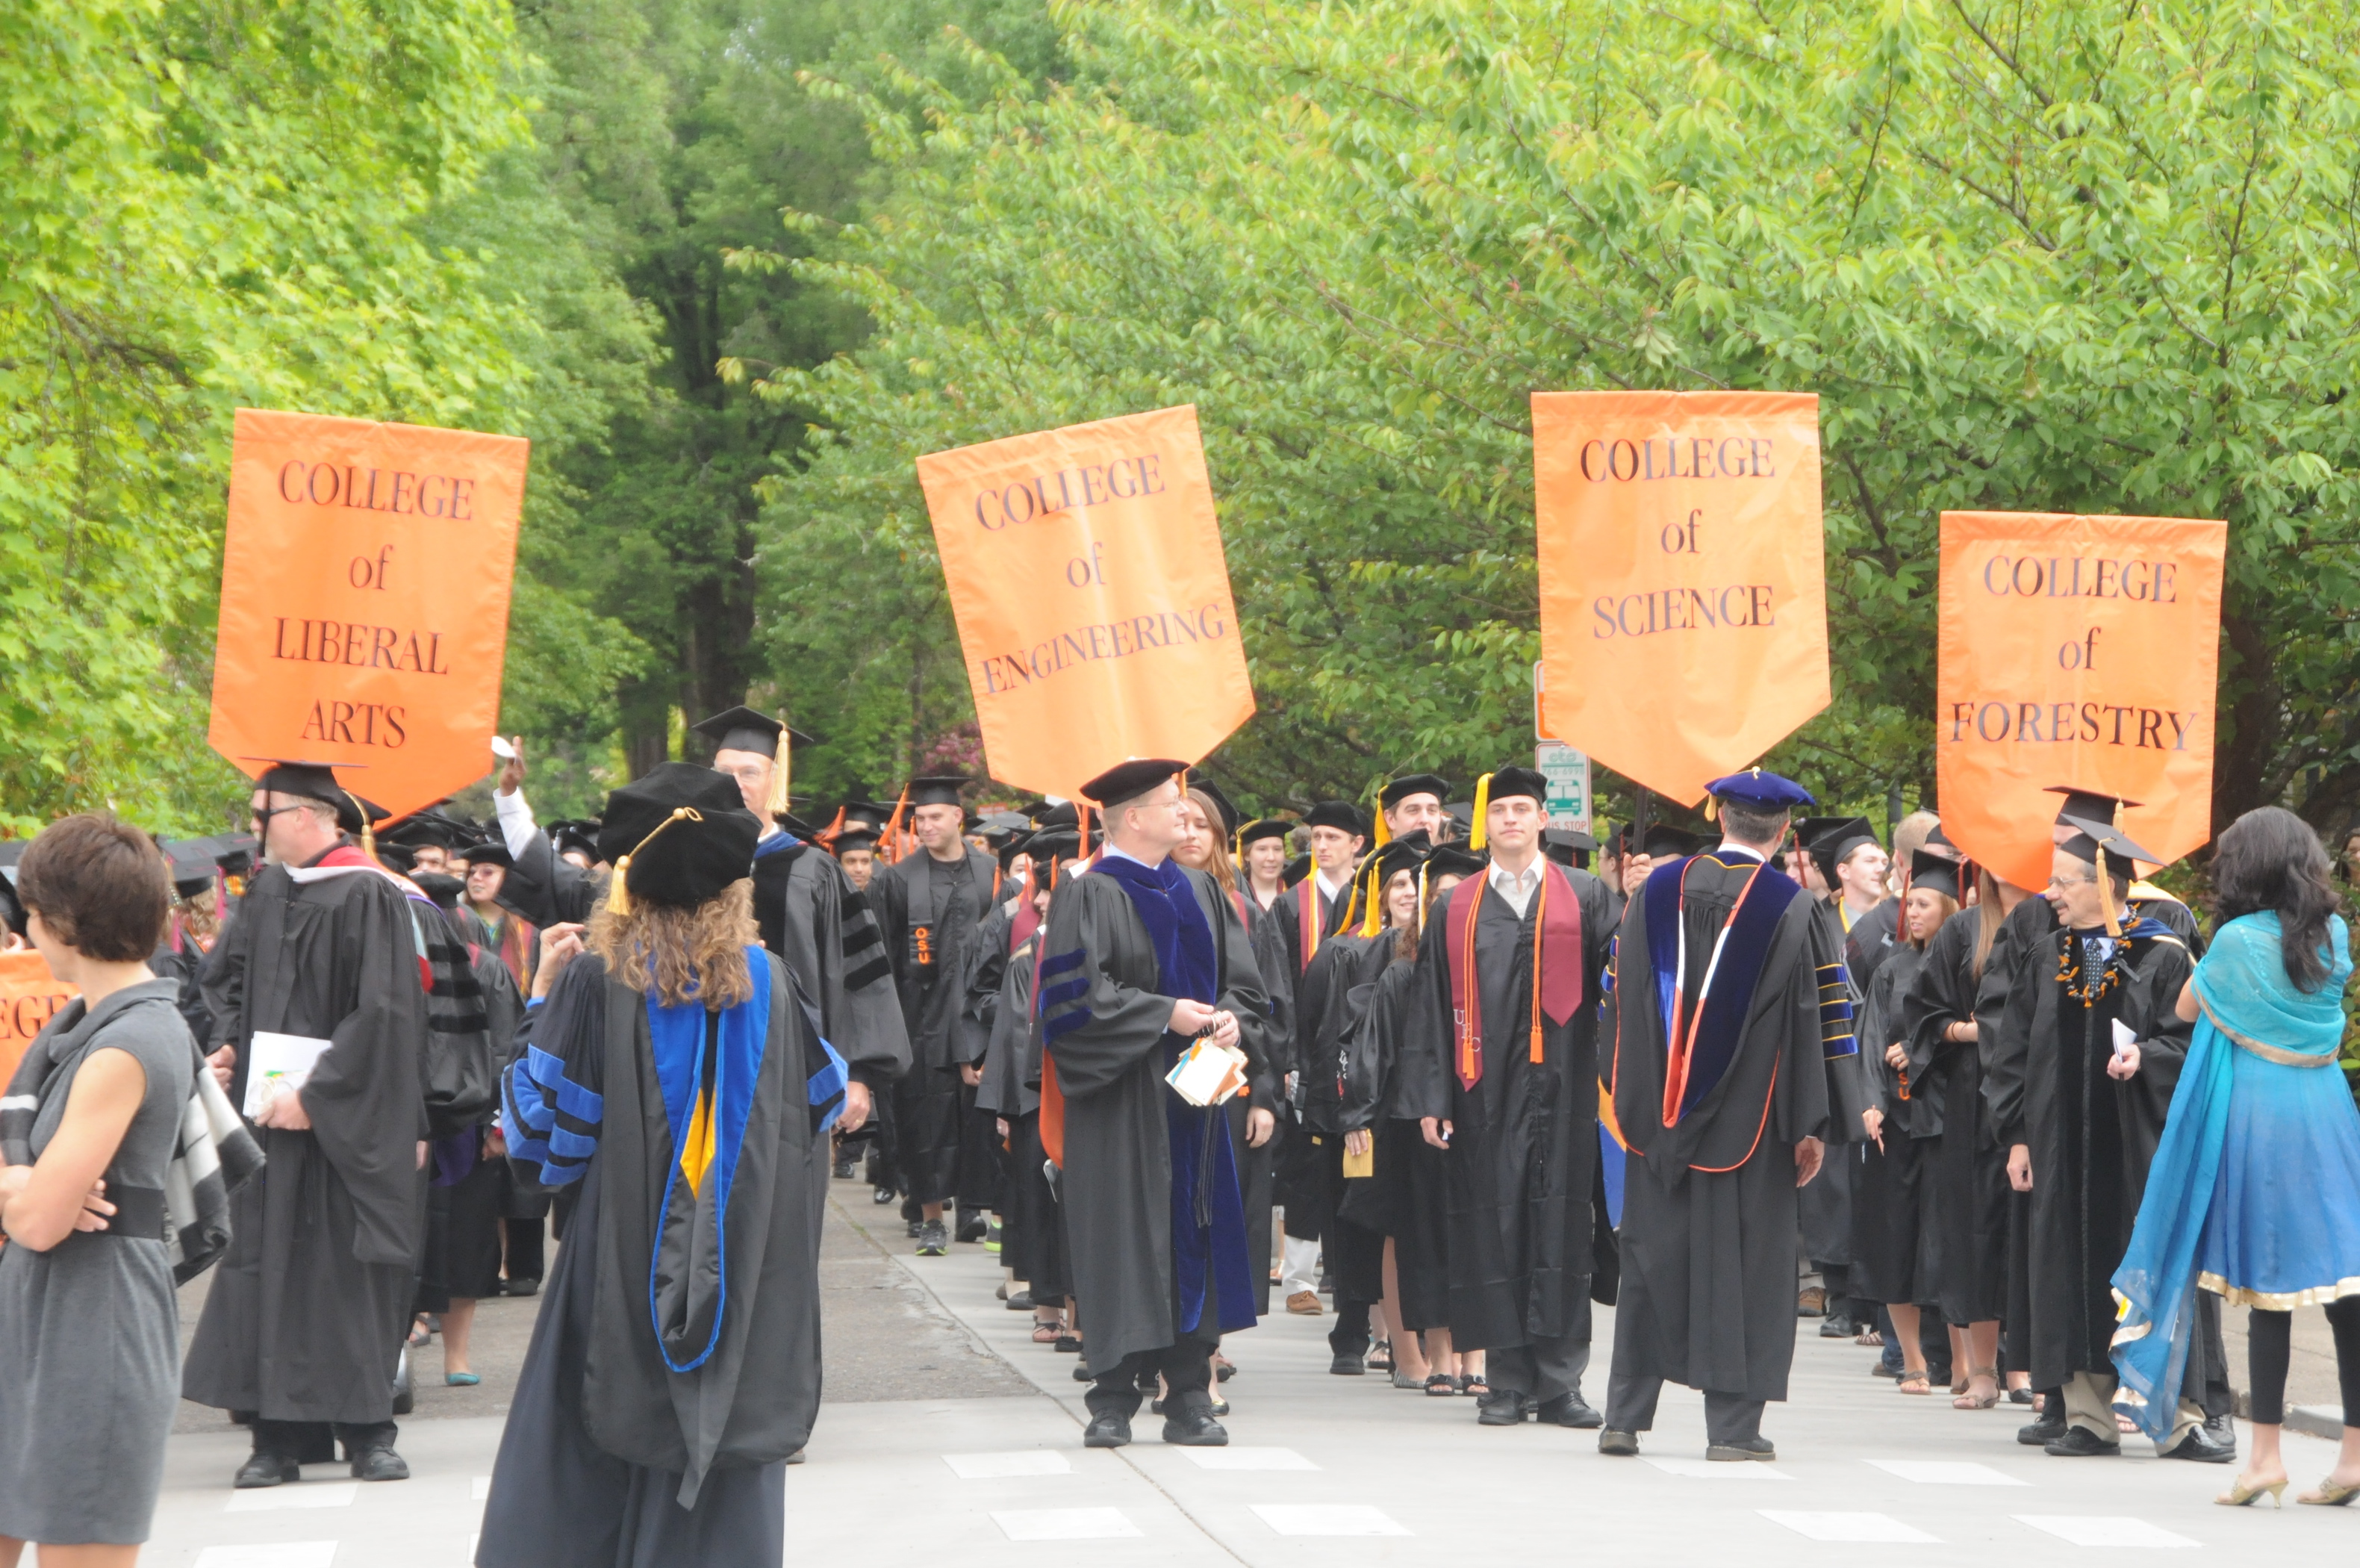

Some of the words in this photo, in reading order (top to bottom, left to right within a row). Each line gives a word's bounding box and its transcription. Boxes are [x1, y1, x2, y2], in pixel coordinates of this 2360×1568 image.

[1580, 436, 1775, 483] COLLEGE
[277, 459, 474, 520] COLLEGE
[975, 453, 1165, 531] COLLEGE
[1660, 508, 1701, 554] of
[348, 544, 393, 591] of
[1066, 541, 1106, 588] of
[1984, 555, 2177, 603] COLLEGE
[1593, 585, 1775, 639] SCIENCE
[271, 617, 448, 675] LIBERAL
[980, 603, 1224, 695] ENGINEERING
[2058, 626, 2101, 671] of
[301, 699, 405, 748] ARTS
[1949, 701, 2198, 751] FORESTRY
[1564, 821, 1587, 831] STOP
[915, 927, 929, 964] OSU
